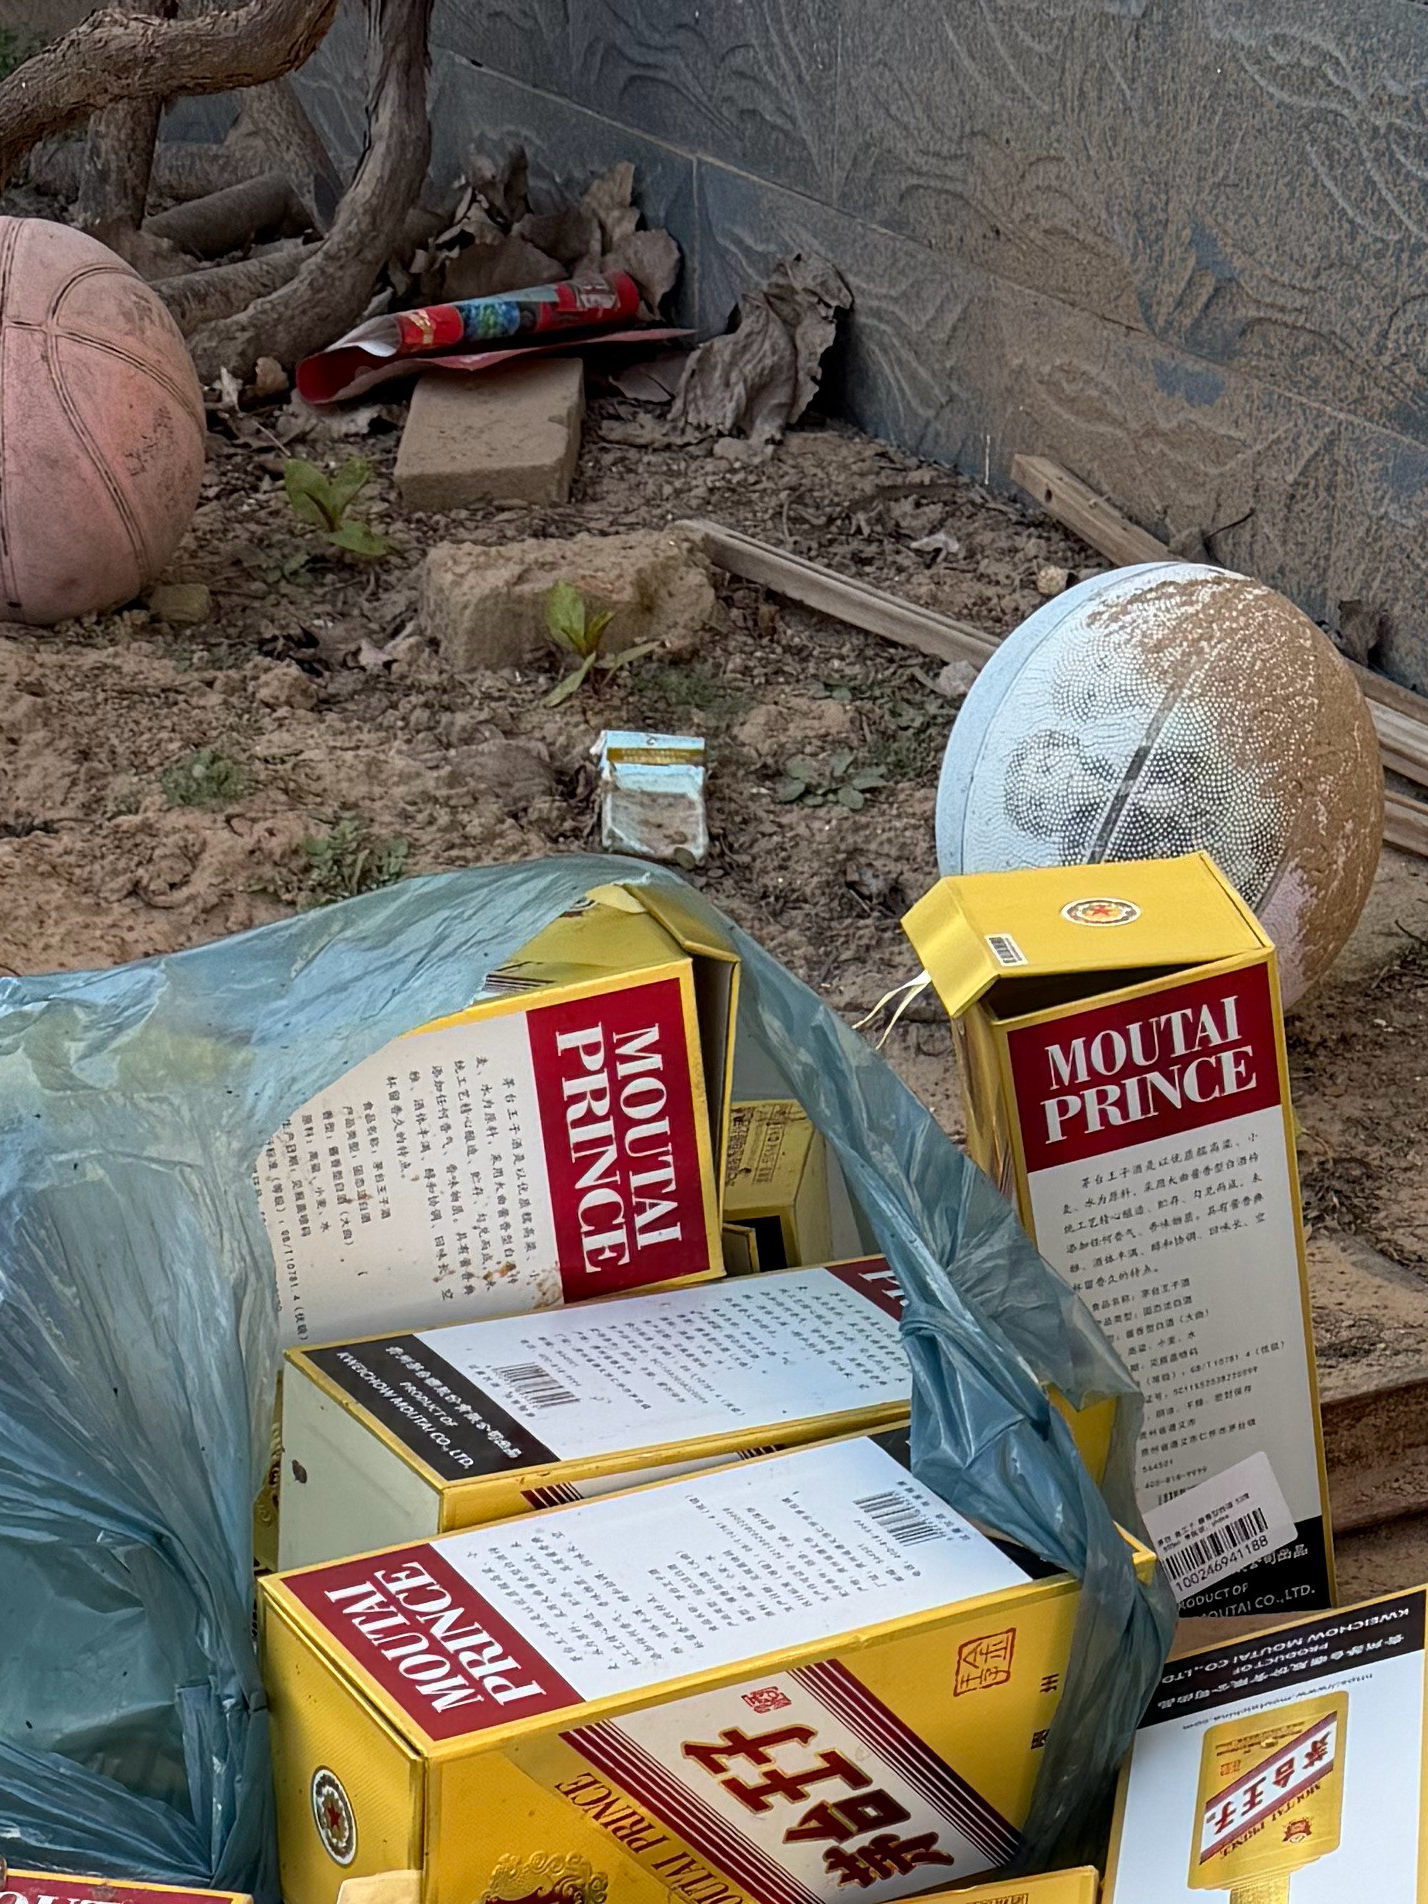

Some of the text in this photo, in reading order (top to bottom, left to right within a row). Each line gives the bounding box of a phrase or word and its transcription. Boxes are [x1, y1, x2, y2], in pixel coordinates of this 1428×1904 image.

[1044, 995, 1242, 1090] MOUTAI
[612, 1022, 682, 1251] MOUTAI
[1040, 1045, 1257, 1145] PRINCE
[555, 1021, 630, 1274] PRINCE
[336, 1352, 436, 1433] KWEICHOW MOUTAI
[399, 1381, 459, 1427] PRODUCT OF
[324, 1580, 485, 1713] MOUTAI
[373, 1561, 547, 1706] PRINCE
[1232, 1608, 1410, 1664] KWEICHOW MOUTAI
[1232, 1642, 1329, 1675] PRODUCT OF
[554, 1772, 670, 1854] PRINCE
[678, 1727, 950, 1890] 茅台王子
[1209, 1731, 1331, 1836] 茅台王子
